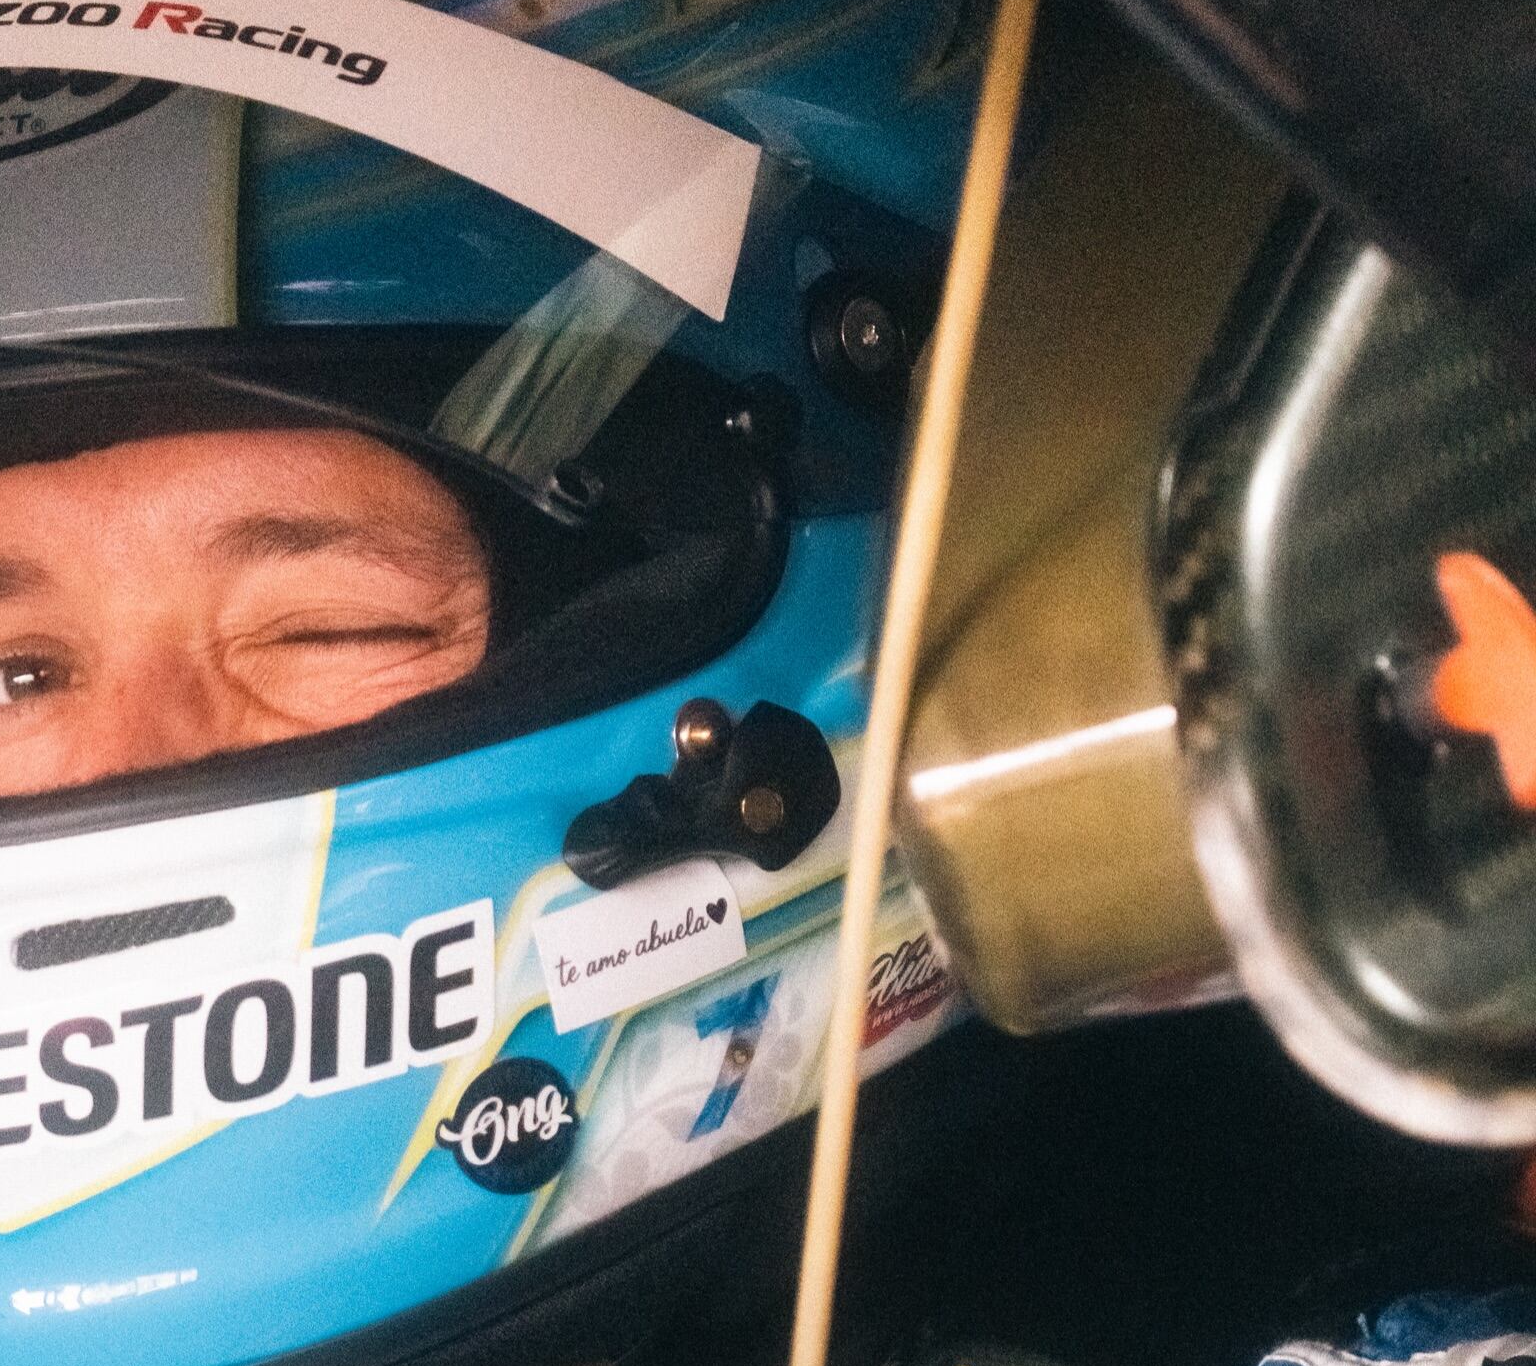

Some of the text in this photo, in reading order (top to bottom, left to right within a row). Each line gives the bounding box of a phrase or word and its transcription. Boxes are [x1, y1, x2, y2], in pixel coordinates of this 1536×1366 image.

[131, 1, 388, 88] Racing
[555, 910, 710, 988] te amo abuela
